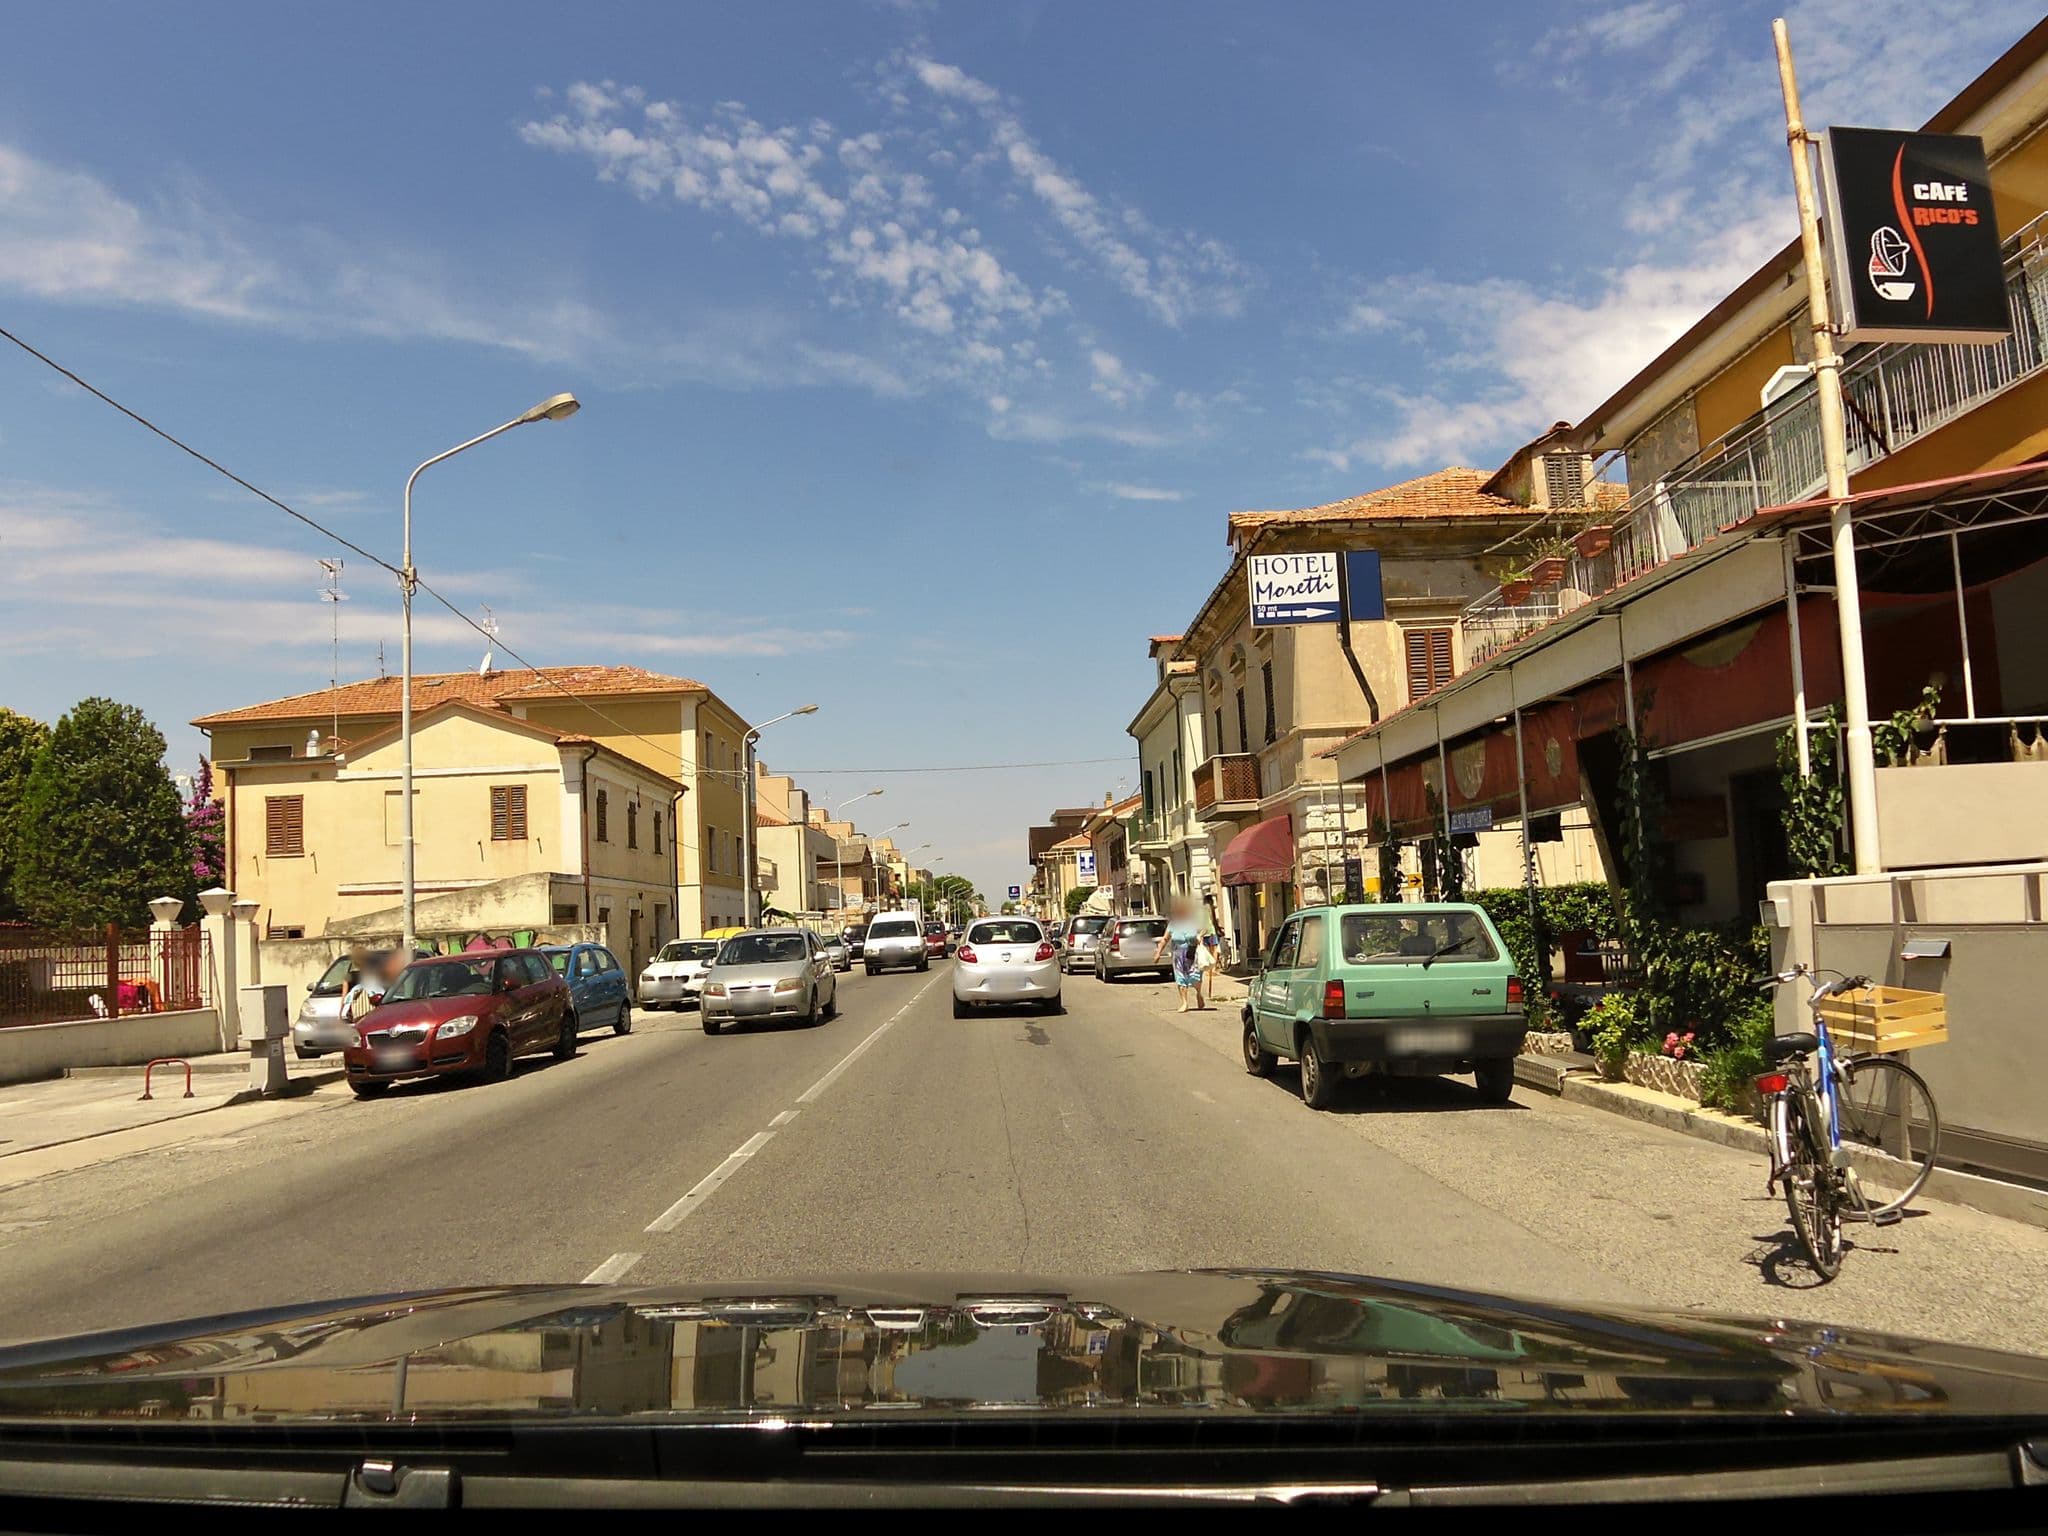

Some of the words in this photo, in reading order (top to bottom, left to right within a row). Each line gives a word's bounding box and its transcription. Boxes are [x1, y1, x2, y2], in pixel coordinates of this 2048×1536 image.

[1913, 207, 1979, 226] RICO'S
[1254, 556, 1334, 576] HOTEL
[1255, 573, 1334, 603] Moretti
[1257, 605, 1266, 613] 50
